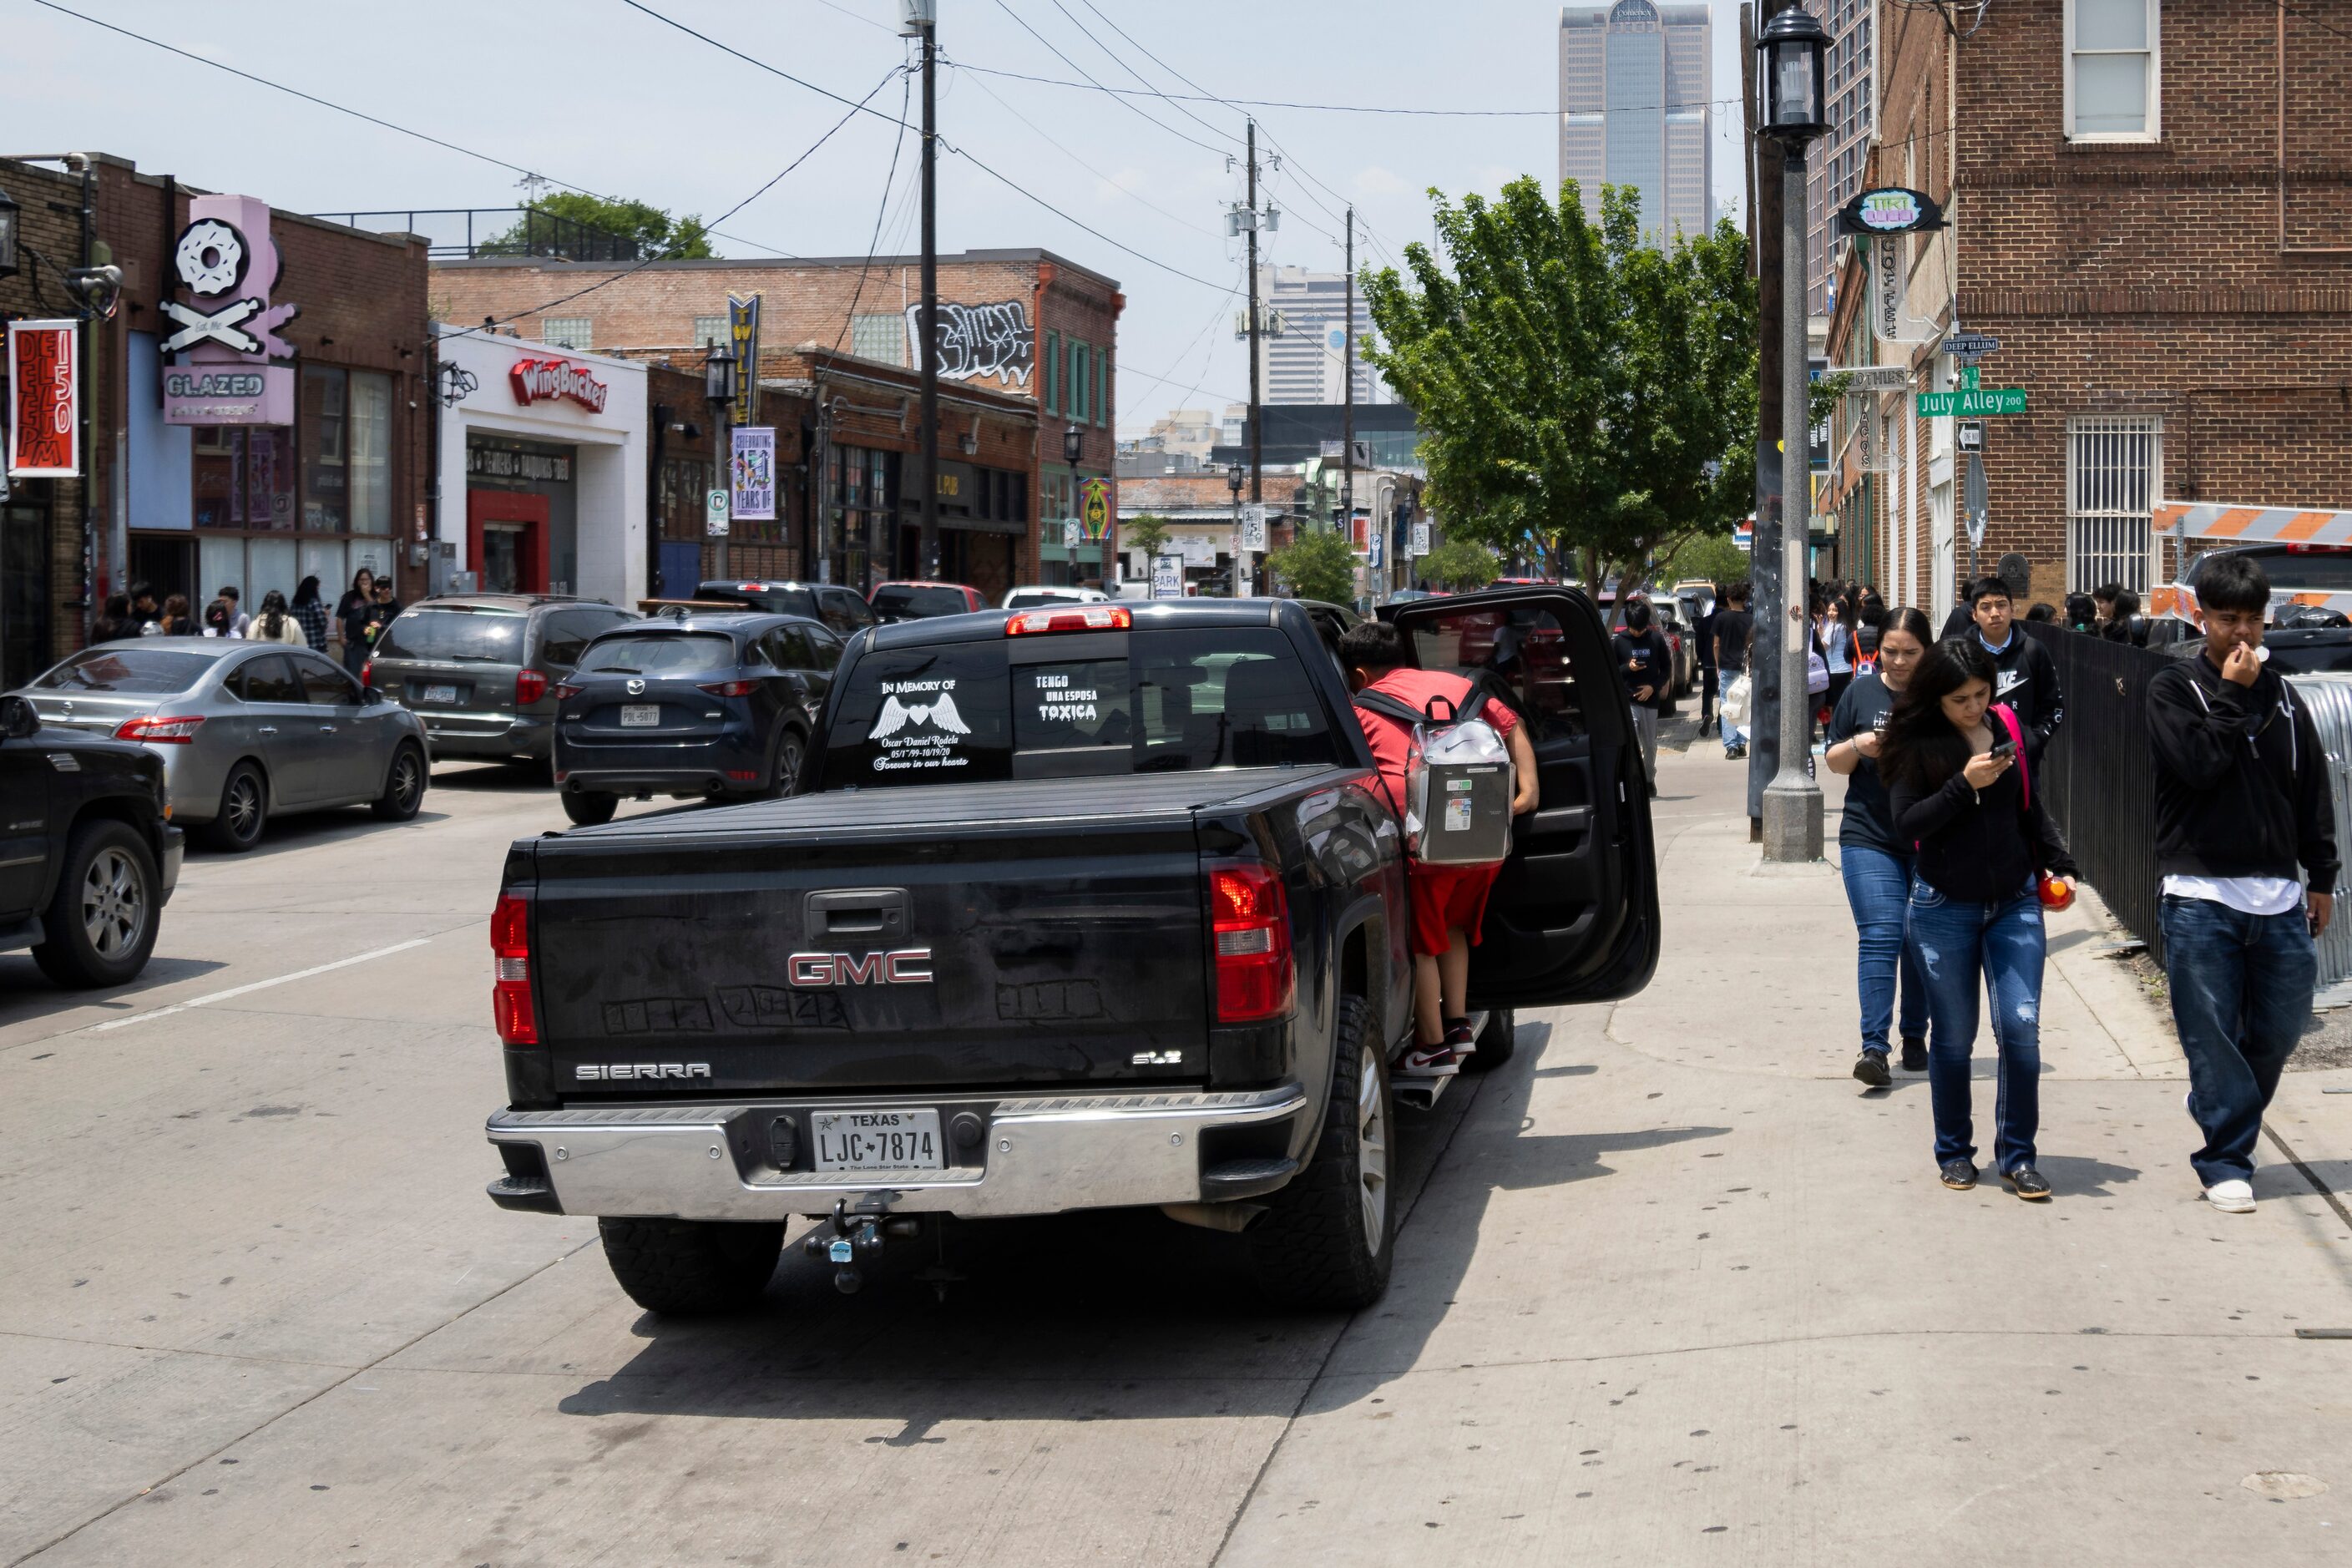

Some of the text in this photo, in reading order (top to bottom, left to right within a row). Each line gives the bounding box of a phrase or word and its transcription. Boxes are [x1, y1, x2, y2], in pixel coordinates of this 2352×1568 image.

[1871, 195, 1909, 210] TIKI
[1881, 237, 1897, 340] COFFEE
[1945, 341, 1995, 351] DEEP ELLUM
[732, 307, 752, 424] TWILITE
[168, 374, 265, 398] GLAZED
[521, 360, 608, 414] WingBucket
[1826, 370, 1905, 387] SOTHIES
[1922, 392, 2021, 415] July Alley 200
[1860, 397, 1870, 467] TACOS
[736, 435, 771, 449] CELEBRATING
[943, 475, 959, 495] PUB
[736, 490, 771, 509] YEARS OF
[1154, 575, 1180, 588] PARK
[1036, 675, 1069, 688] TENGO
[1997, 670, 2017, 688] IKE
[1046, 690, 1097, 701] UNA ESPOSA
[1039, 705, 1097, 722] TOXICA
[882, 735, 959, 748] Oscar Daniel Rodela
[874, 757, 912, 771] Forever
[913, 760, 923, 768] in
[942, 756, 969, 766] hearts
[788, 948, 933, 985] GMC
[576, 1064, 711, 1080] SIERRA
[851, 1115, 900, 1126] TEXAS
